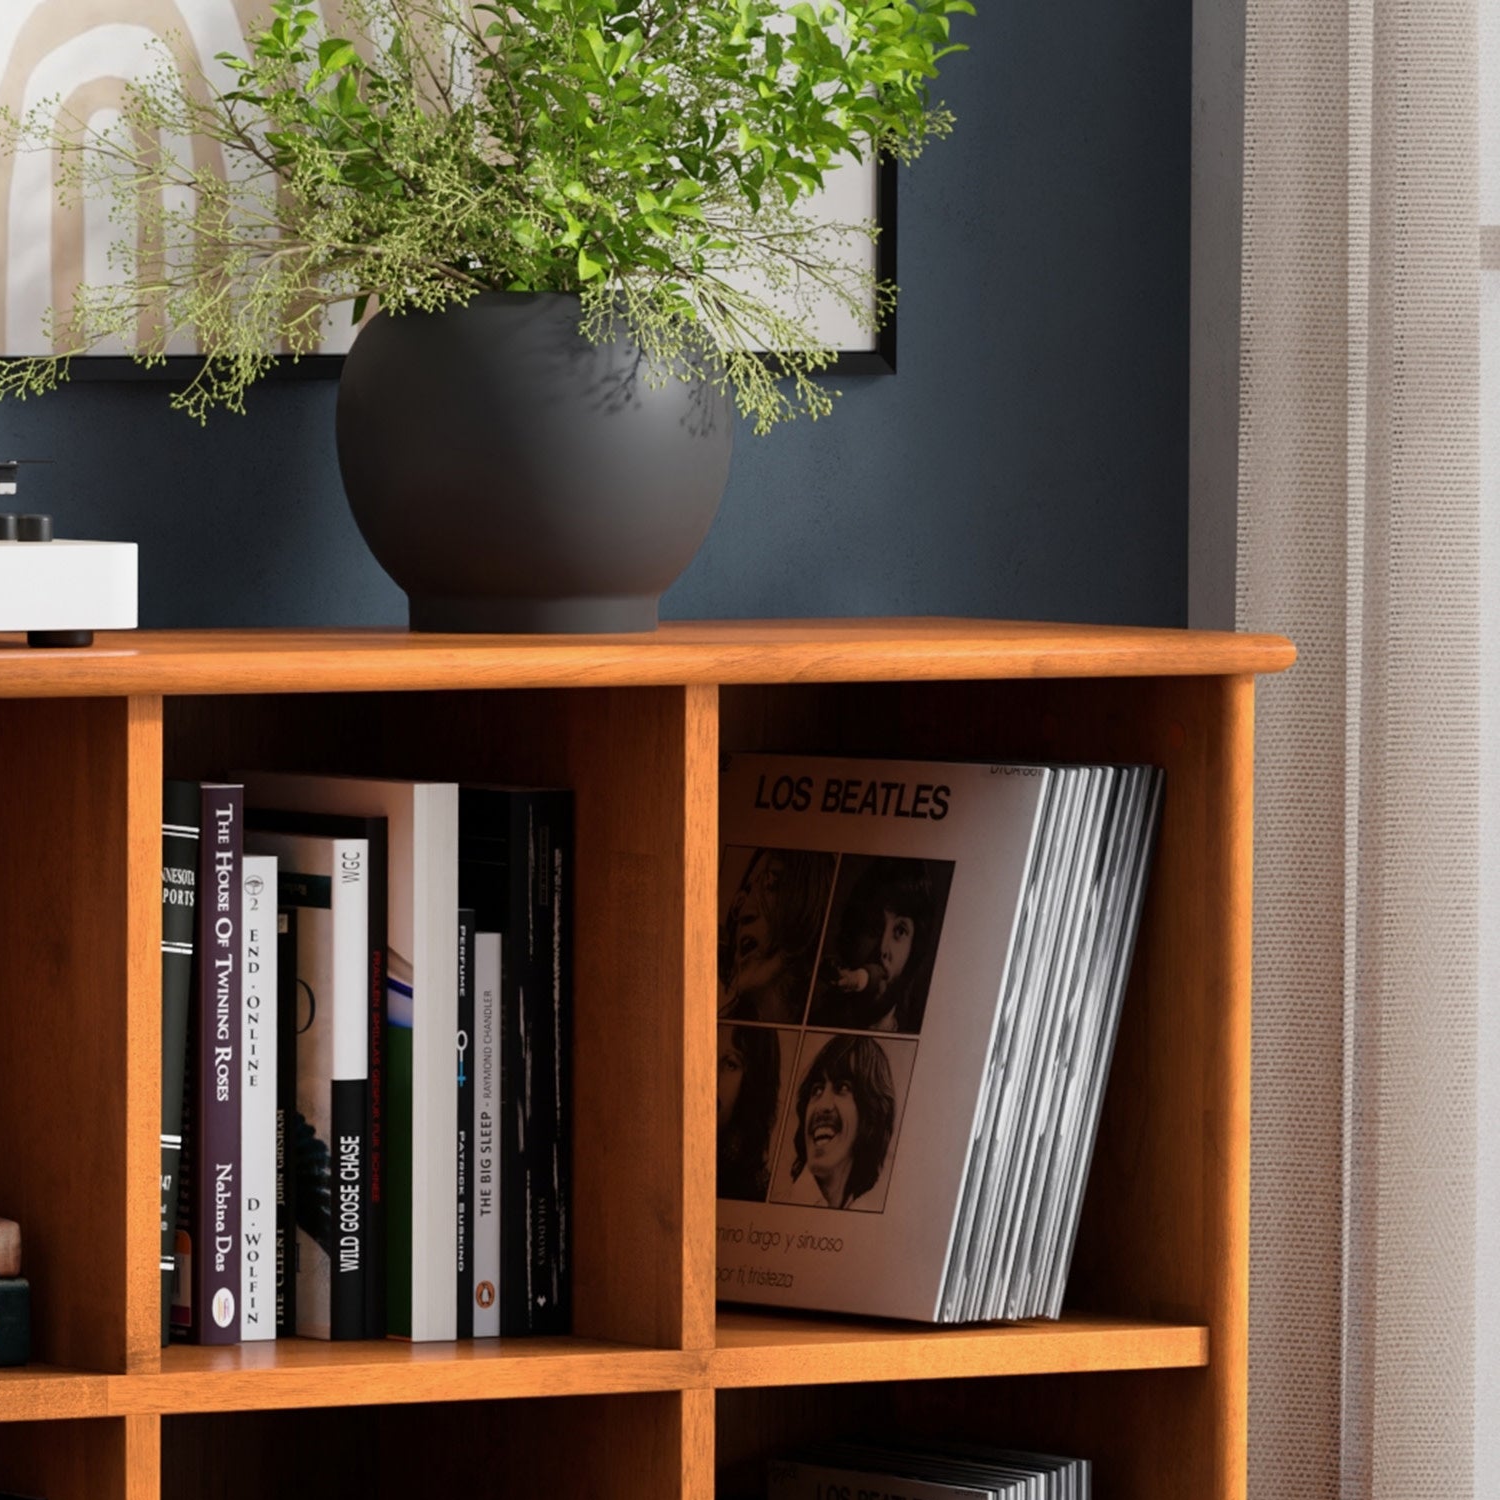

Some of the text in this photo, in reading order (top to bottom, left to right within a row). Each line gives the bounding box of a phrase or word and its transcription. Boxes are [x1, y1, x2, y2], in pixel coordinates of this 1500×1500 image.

[215, 803, 234, 844] THE
[755, 774, 951, 821] LOS BEATLES
[215, 851, 234, 911] HOUSE
[342, 851, 361, 884] WGC
[458, 925, 467, 997] PERFUME
[215, 953, 234, 1040] TWINING
[246, 929, 260, 1087] END ONLINE
[483, 990, 493, 1043] CHANDLER
[215, 1046, 233, 1102] ROSES
[483, 1046, 493, 1099] RAYMOND
[480, 1111, 492, 1155] SLEEP
[480, 1158, 492, 1183] BIG
[215, 1164, 233, 1273] Nabina Das
[340, 1135, 360, 1273] WILD GOOSE CHASE
[480, 1187, 492, 1217] THE
[750, 1222, 781, 1251] largo
[785, 1233, 795, 1254] y
[798, 1230, 844, 1252] sinuoso
